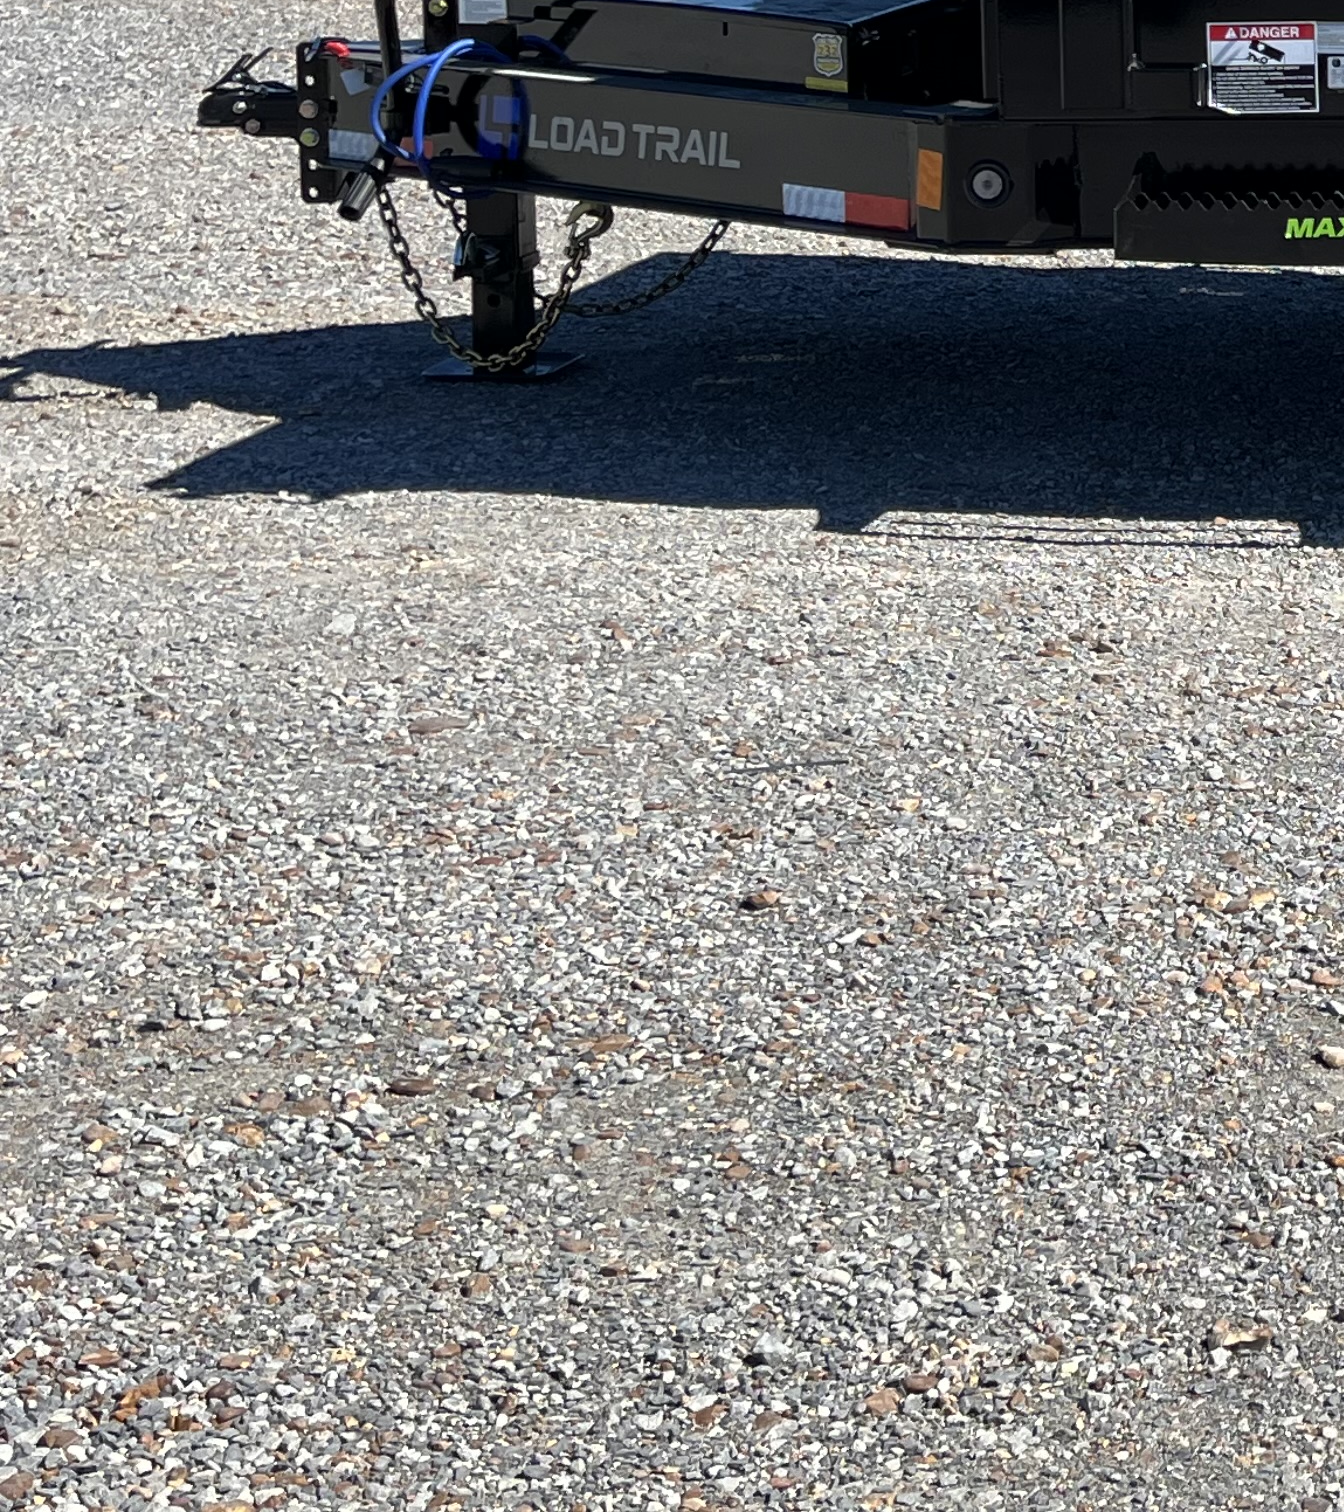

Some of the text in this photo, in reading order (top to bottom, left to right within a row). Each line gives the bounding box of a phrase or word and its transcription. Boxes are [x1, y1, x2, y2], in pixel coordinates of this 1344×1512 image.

[1238, 26, 1300, 39] DANGER
[528, 113, 741, 169] LOAD TRAIL
